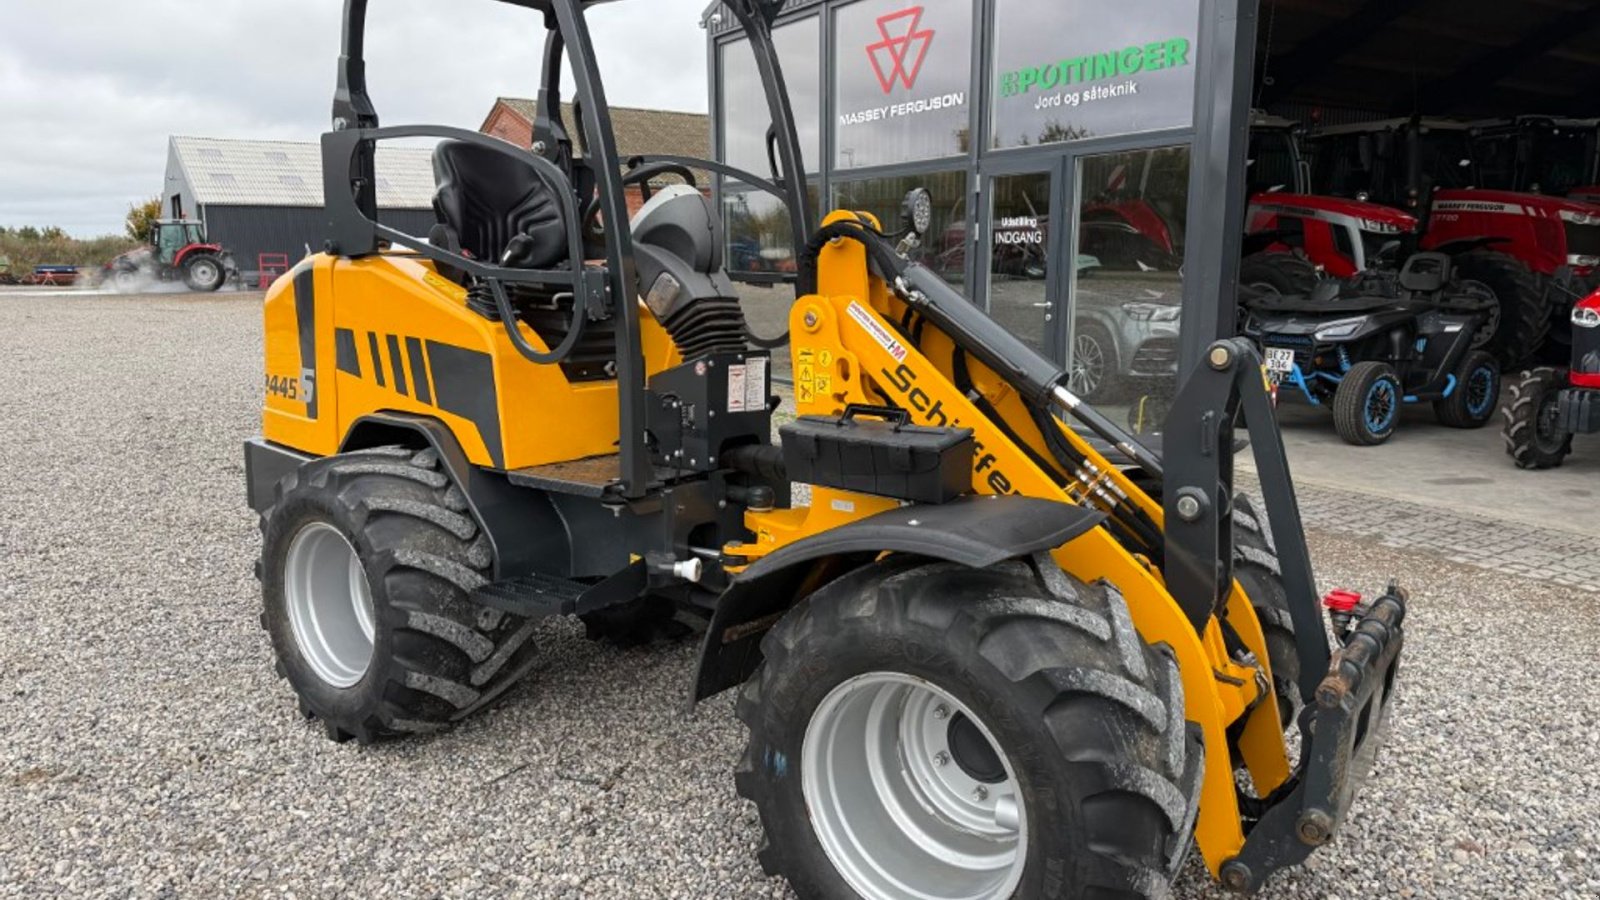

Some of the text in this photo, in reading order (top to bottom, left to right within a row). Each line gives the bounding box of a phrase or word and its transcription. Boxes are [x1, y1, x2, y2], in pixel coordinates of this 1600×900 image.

[839, 92, 964, 125] MASSEY FERGUSON
[1034, 80, 1137, 110] Jord og såteknik
[995, 231, 1042, 244] INDGANG
[881, 364, 1023, 495] Schffe
